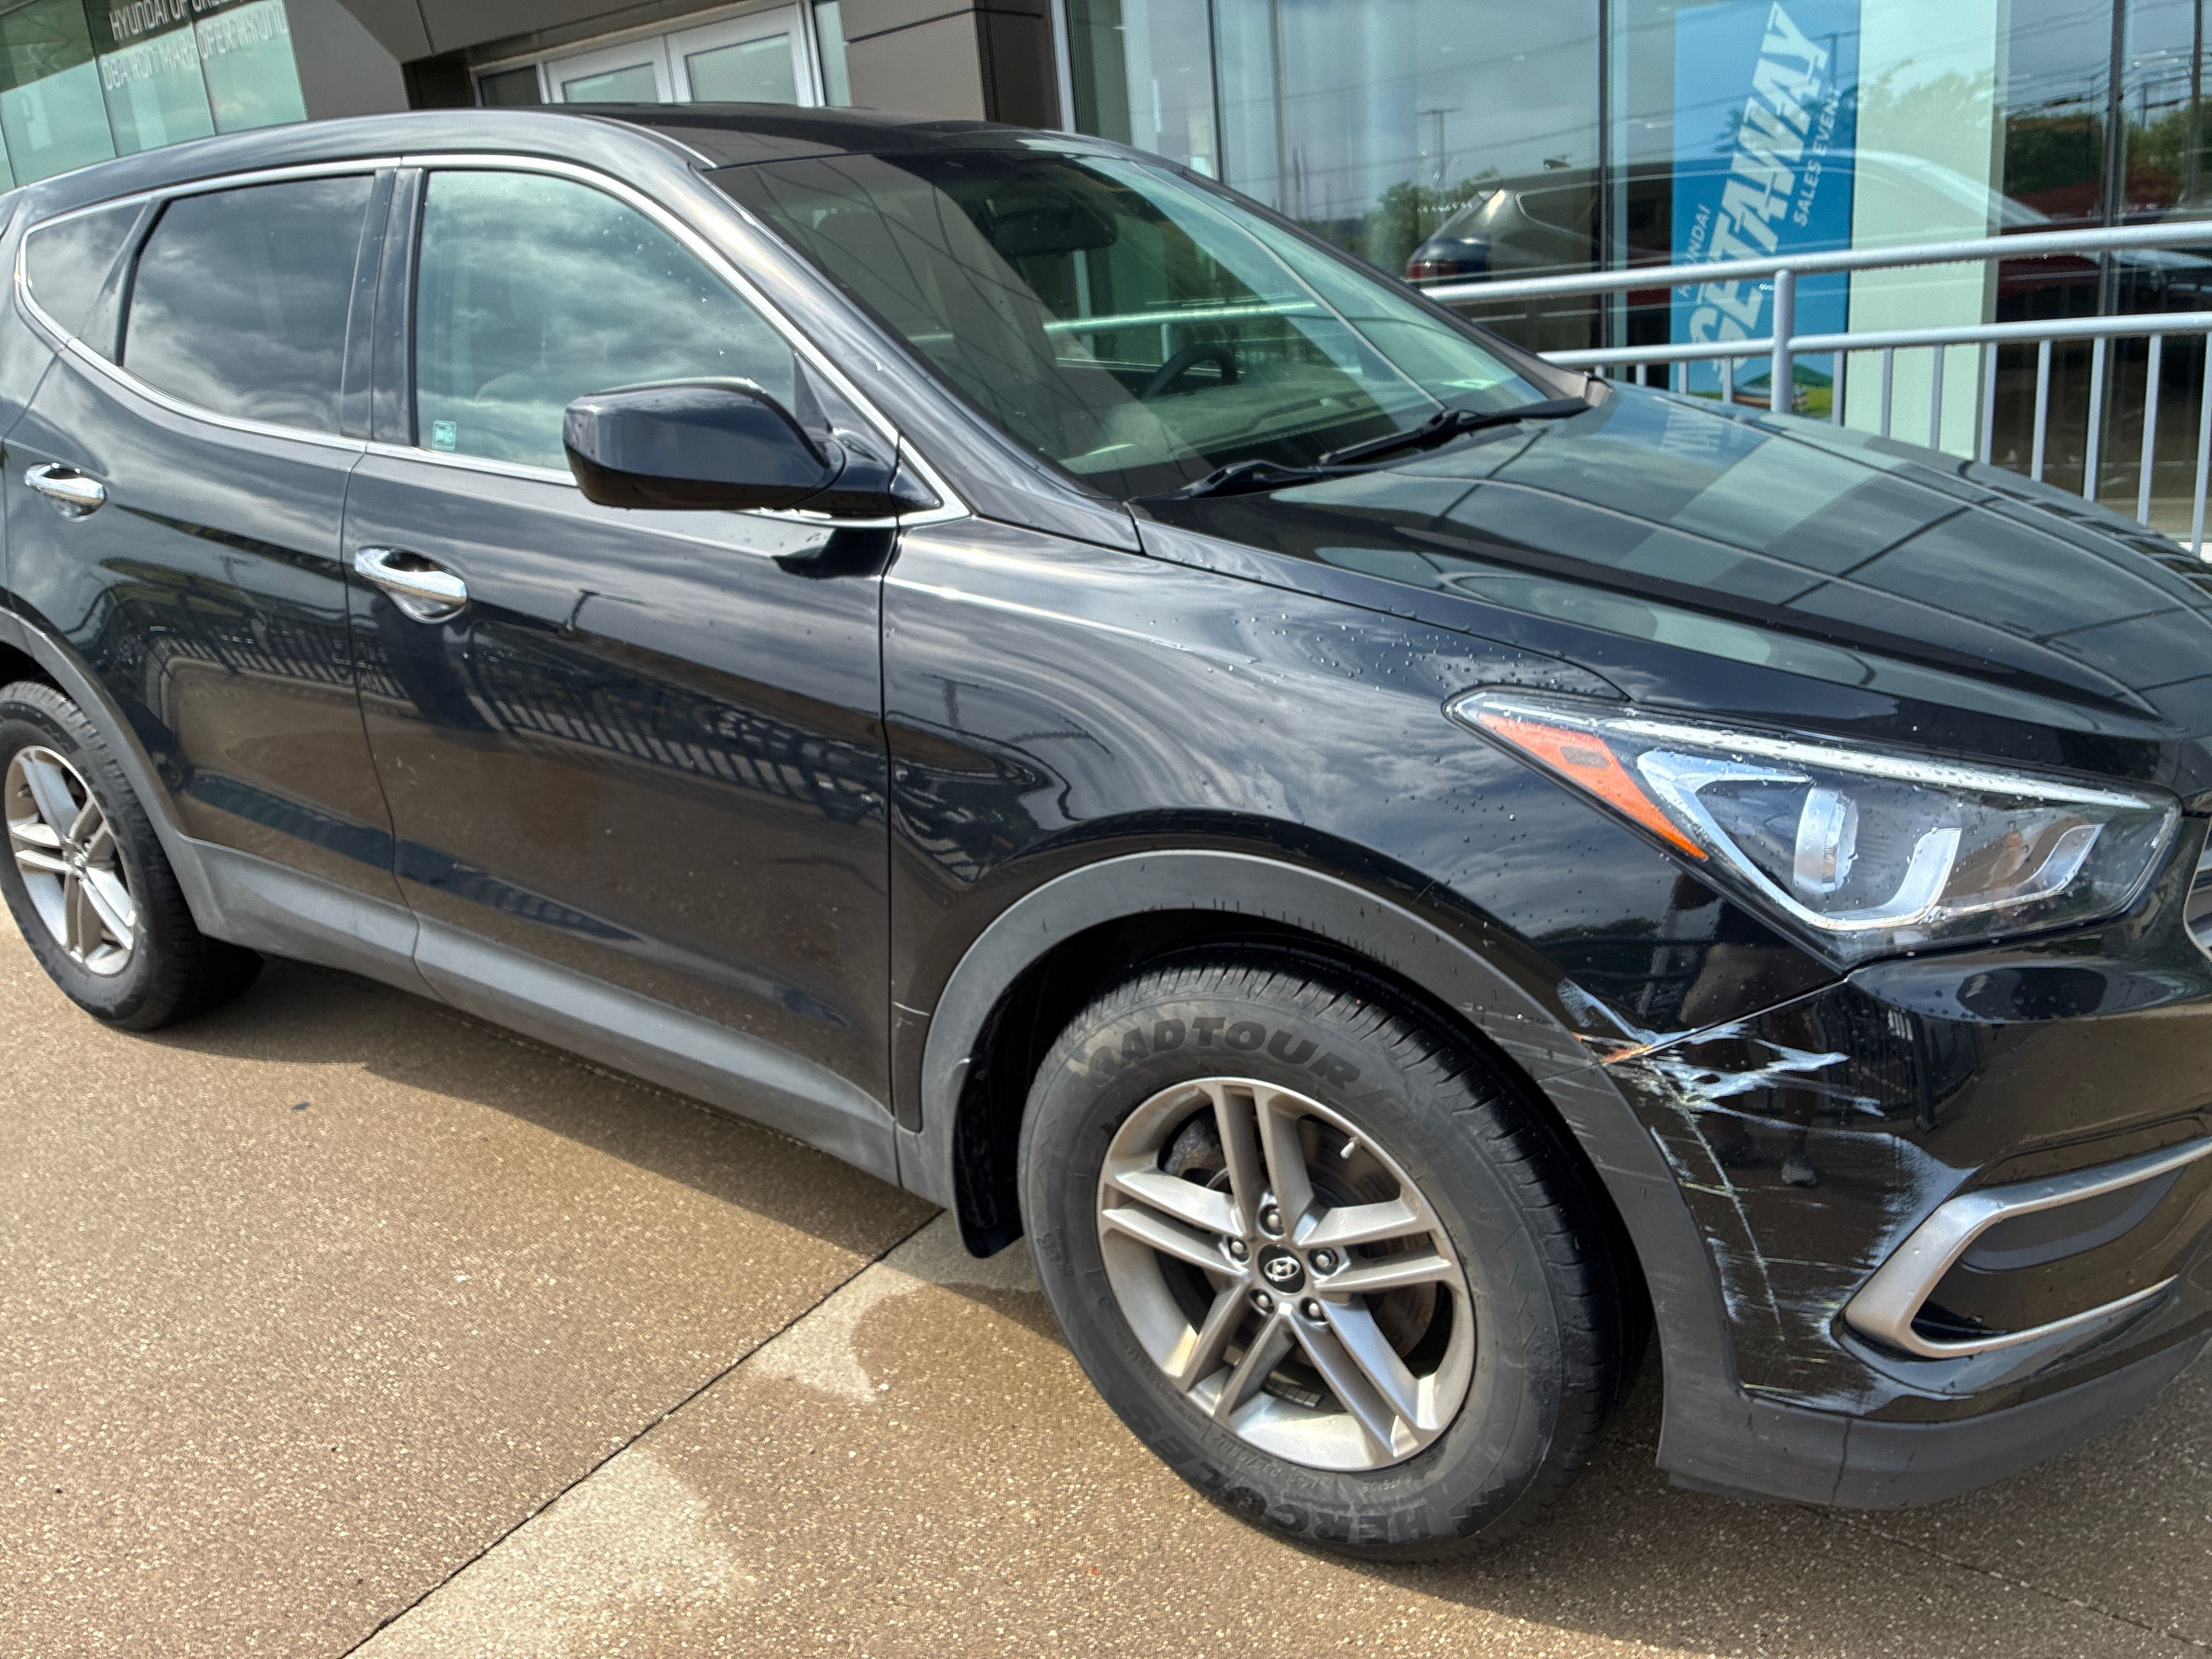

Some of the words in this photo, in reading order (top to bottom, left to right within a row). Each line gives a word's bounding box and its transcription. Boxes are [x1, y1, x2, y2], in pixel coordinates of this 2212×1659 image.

[109, 0, 170, 42] HYUNDAI
[1689, 2, 1829, 383] GETAWAY
[1793, 159, 1822, 228] SALES
[1812, 82, 1841, 156] EVENT
[1678, 202, 1711, 298] HNDAI
